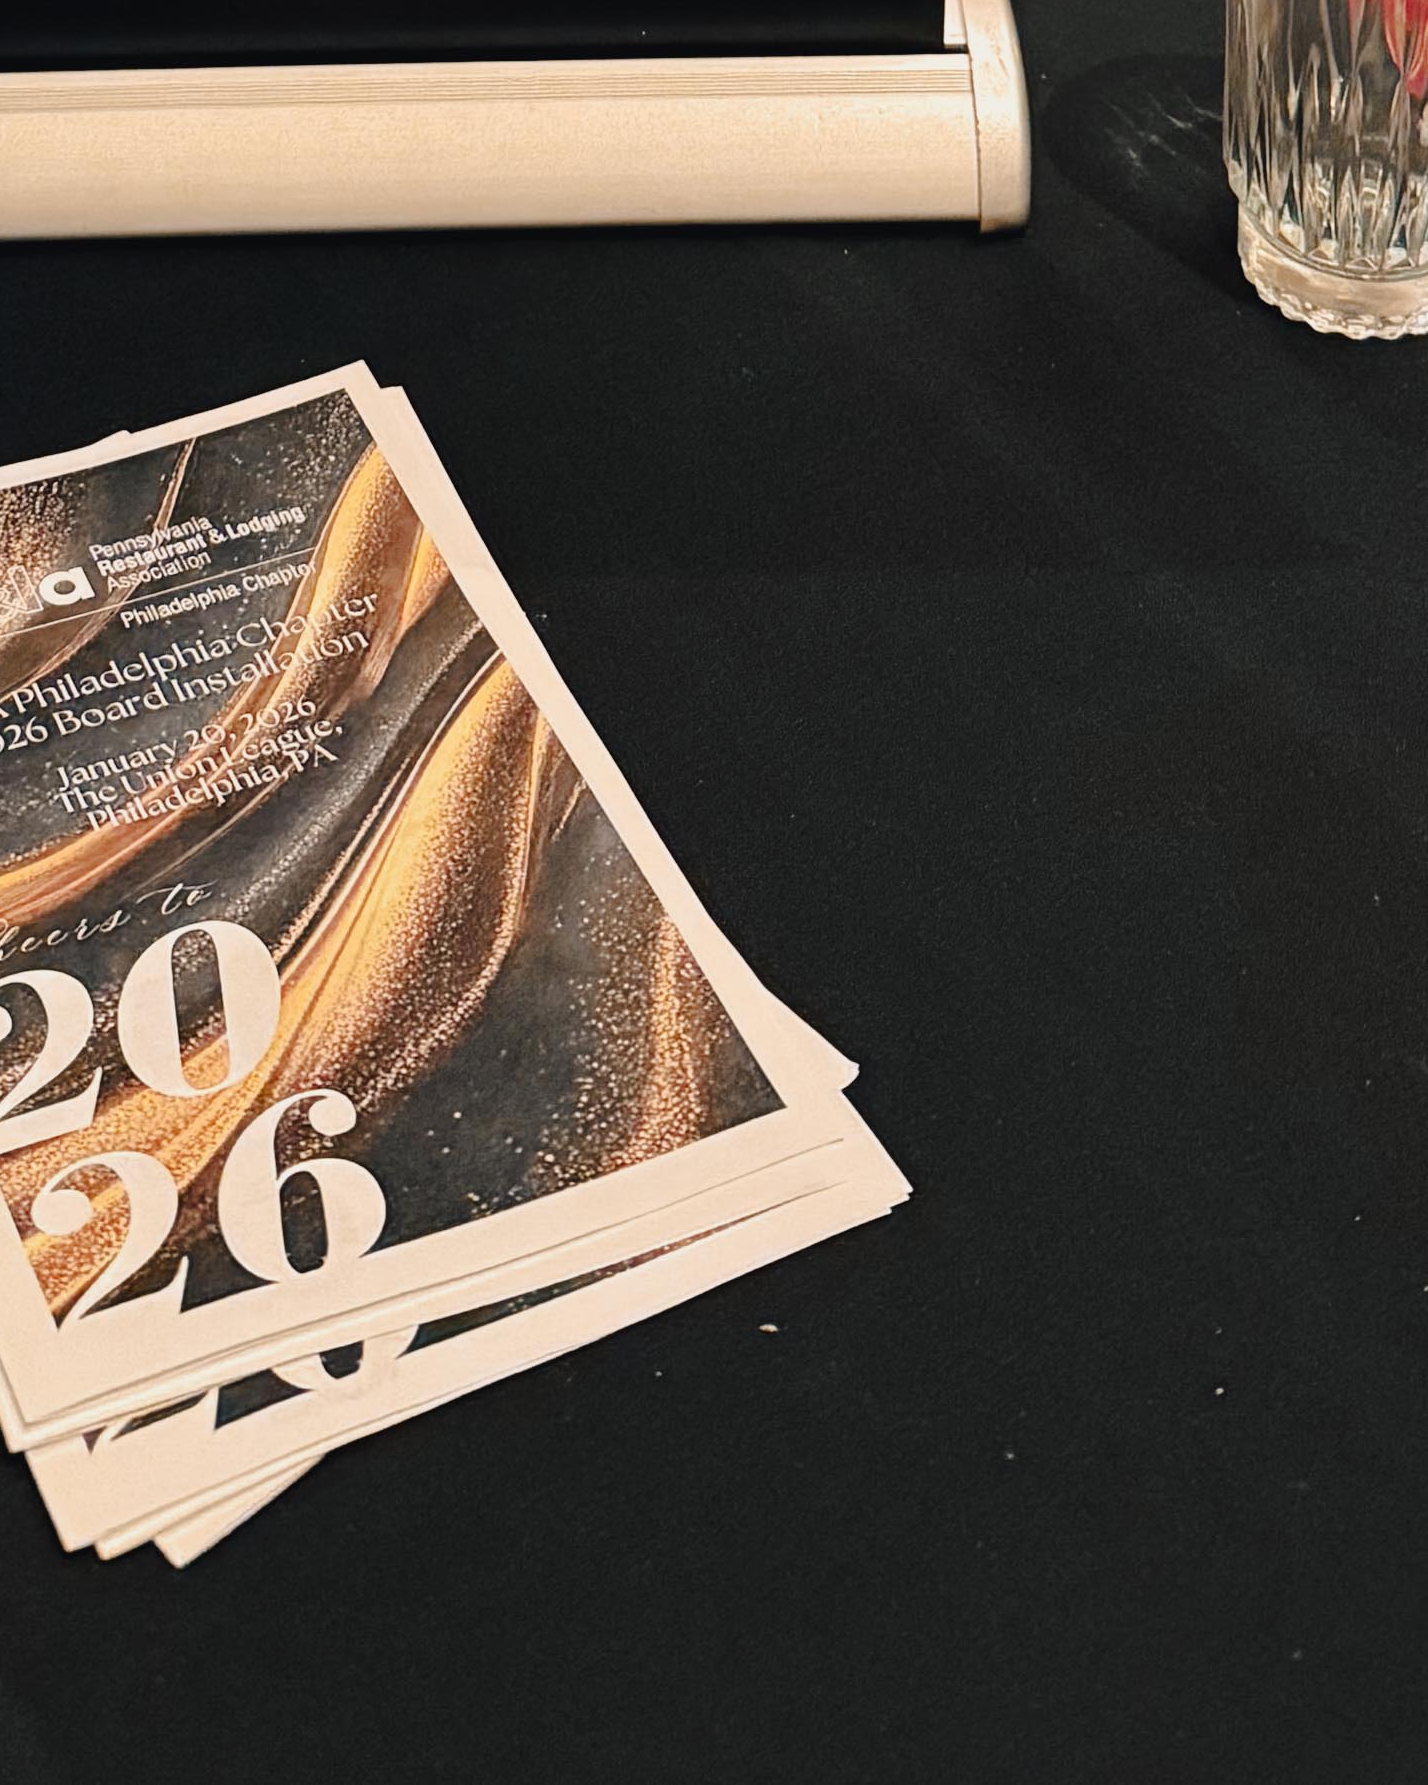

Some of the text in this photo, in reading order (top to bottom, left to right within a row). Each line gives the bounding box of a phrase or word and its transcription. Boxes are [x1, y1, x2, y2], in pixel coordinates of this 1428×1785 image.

[89, 514, 213, 561] Pennsylvania
[96, 505, 308, 577] Restaurant & Lodging
[107, 550, 212, 594] Association
[120, 582, 242, 629] Philadelphia
[10, 638, 233, 714] Philadelphia
[236, 592, 379, 650] Chapter
[52, 681, 170, 737] Board
[170, 630, 371, 703] Installation
[52, 719, 344, 814] The Union League,
[56, 698, 317, 792] January 20, 2026
[86, 743, 339, 832] Philadelphia, PA
[135, 880, 218, 916] to
[29, 1088, 387, 1328] 26
